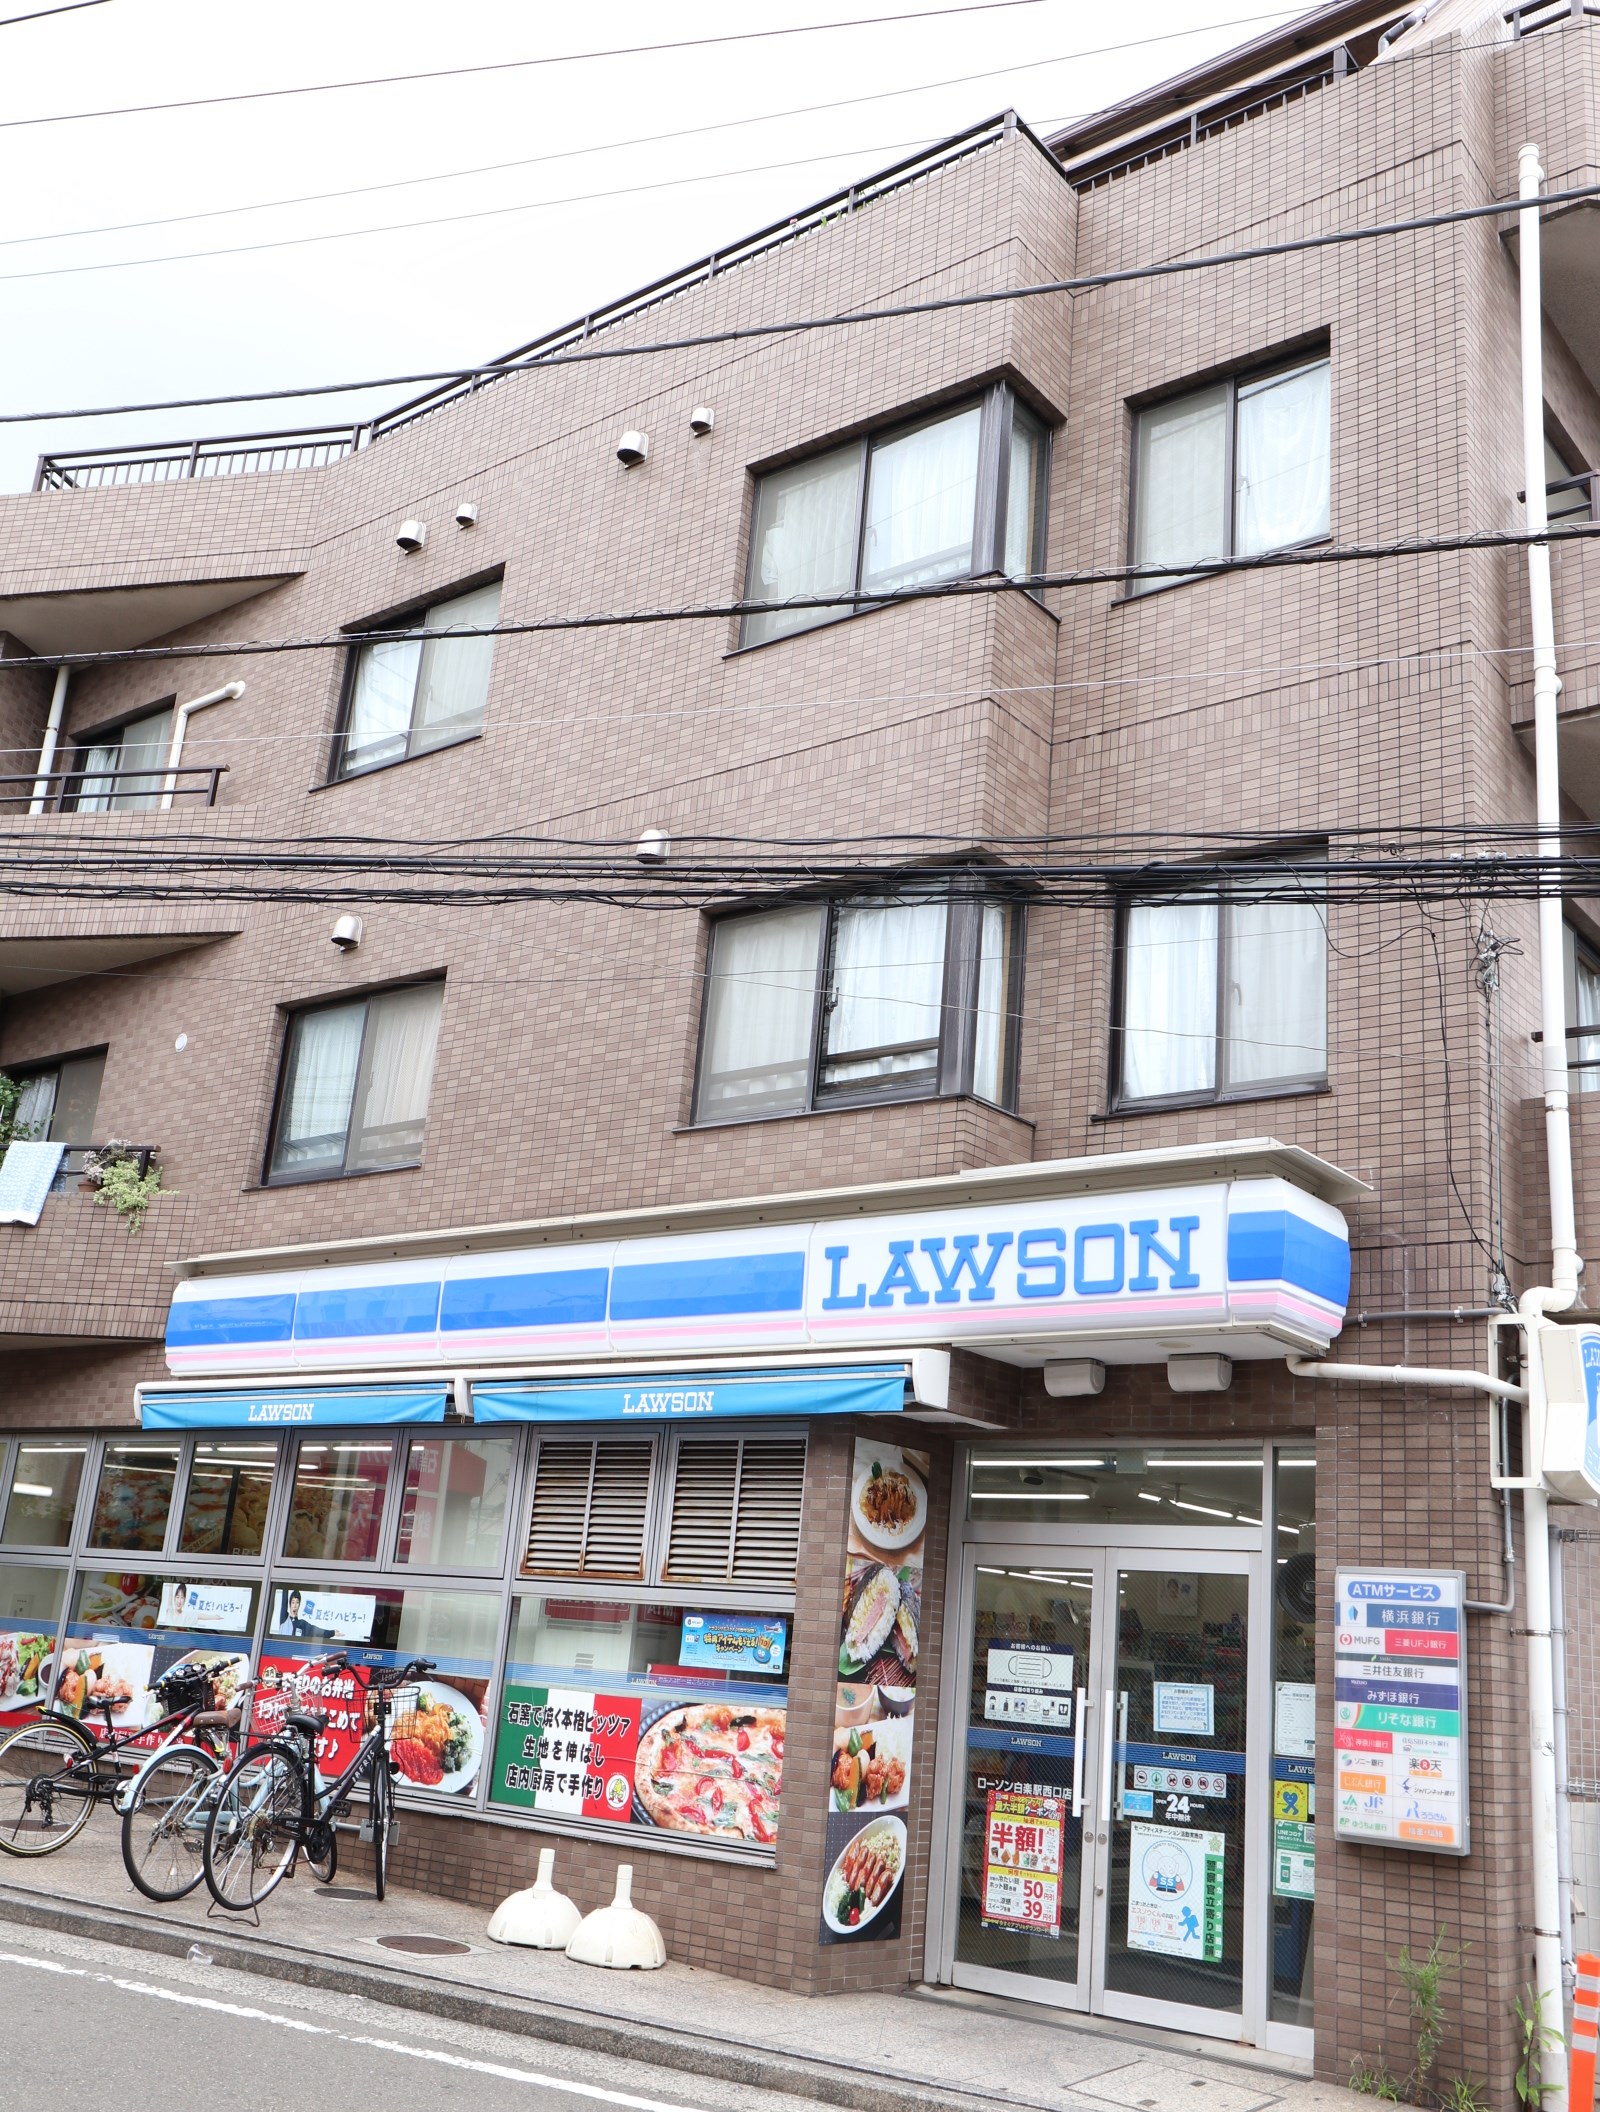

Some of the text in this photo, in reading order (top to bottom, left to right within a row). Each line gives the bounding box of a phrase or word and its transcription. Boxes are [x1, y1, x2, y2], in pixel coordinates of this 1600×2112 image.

[822, 1215, 1200, 1310] LAWSON
[623, 1390, 714, 1414] LAWSON
[248, 1403, 314, 1422] LAWSON
[1352, 1583, 1436, 1599] ATMサービス
[1381, 1609, 1441, 1626] 横浜銀行
[148, 1633, 166, 1641] LAWSON
[1353, 1636, 1381, 1646] MUFG
[1394, 1638, 1448, 1650] 三菱UFJ銀行
[362, 1652, 384, 1661] LAWSON
[1362, 1664, 1425, 1679] 三井住友銀行
[1367, 1690, 1420, 1705] みずほ銀行
[507, 1701, 632, 1738] 石窯で焼く本格ピッツァ
[1378, 1712, 1437, 1729] りそな銀行
[1010, 1737, 1042, 1747] LAWSON
[522, 1734, 605, 1768] 生地を伸ばし
[1162, 1751, 1197, 1762] LAWSON
[1287, 1765, 1315, 1776] LAWS
[1354, 1758, 1384, 1767] ソニー銀行
[505, 1763, 605, 1800] 店内厨房で手作り
[977, 1777, 1073, 1800] ローソン白楽駅西口店
[1166, 1793, 1190, 1814] 24
[1164, 1812, 1192, 1823] 年中無休
[991, 1822, 1044, 1855] 半額!
[1023, 1879, 1044, 1899] 50
[1159, 1876, 1174, 1887] SS
[1022, 1899, 1043, 1919] 39
